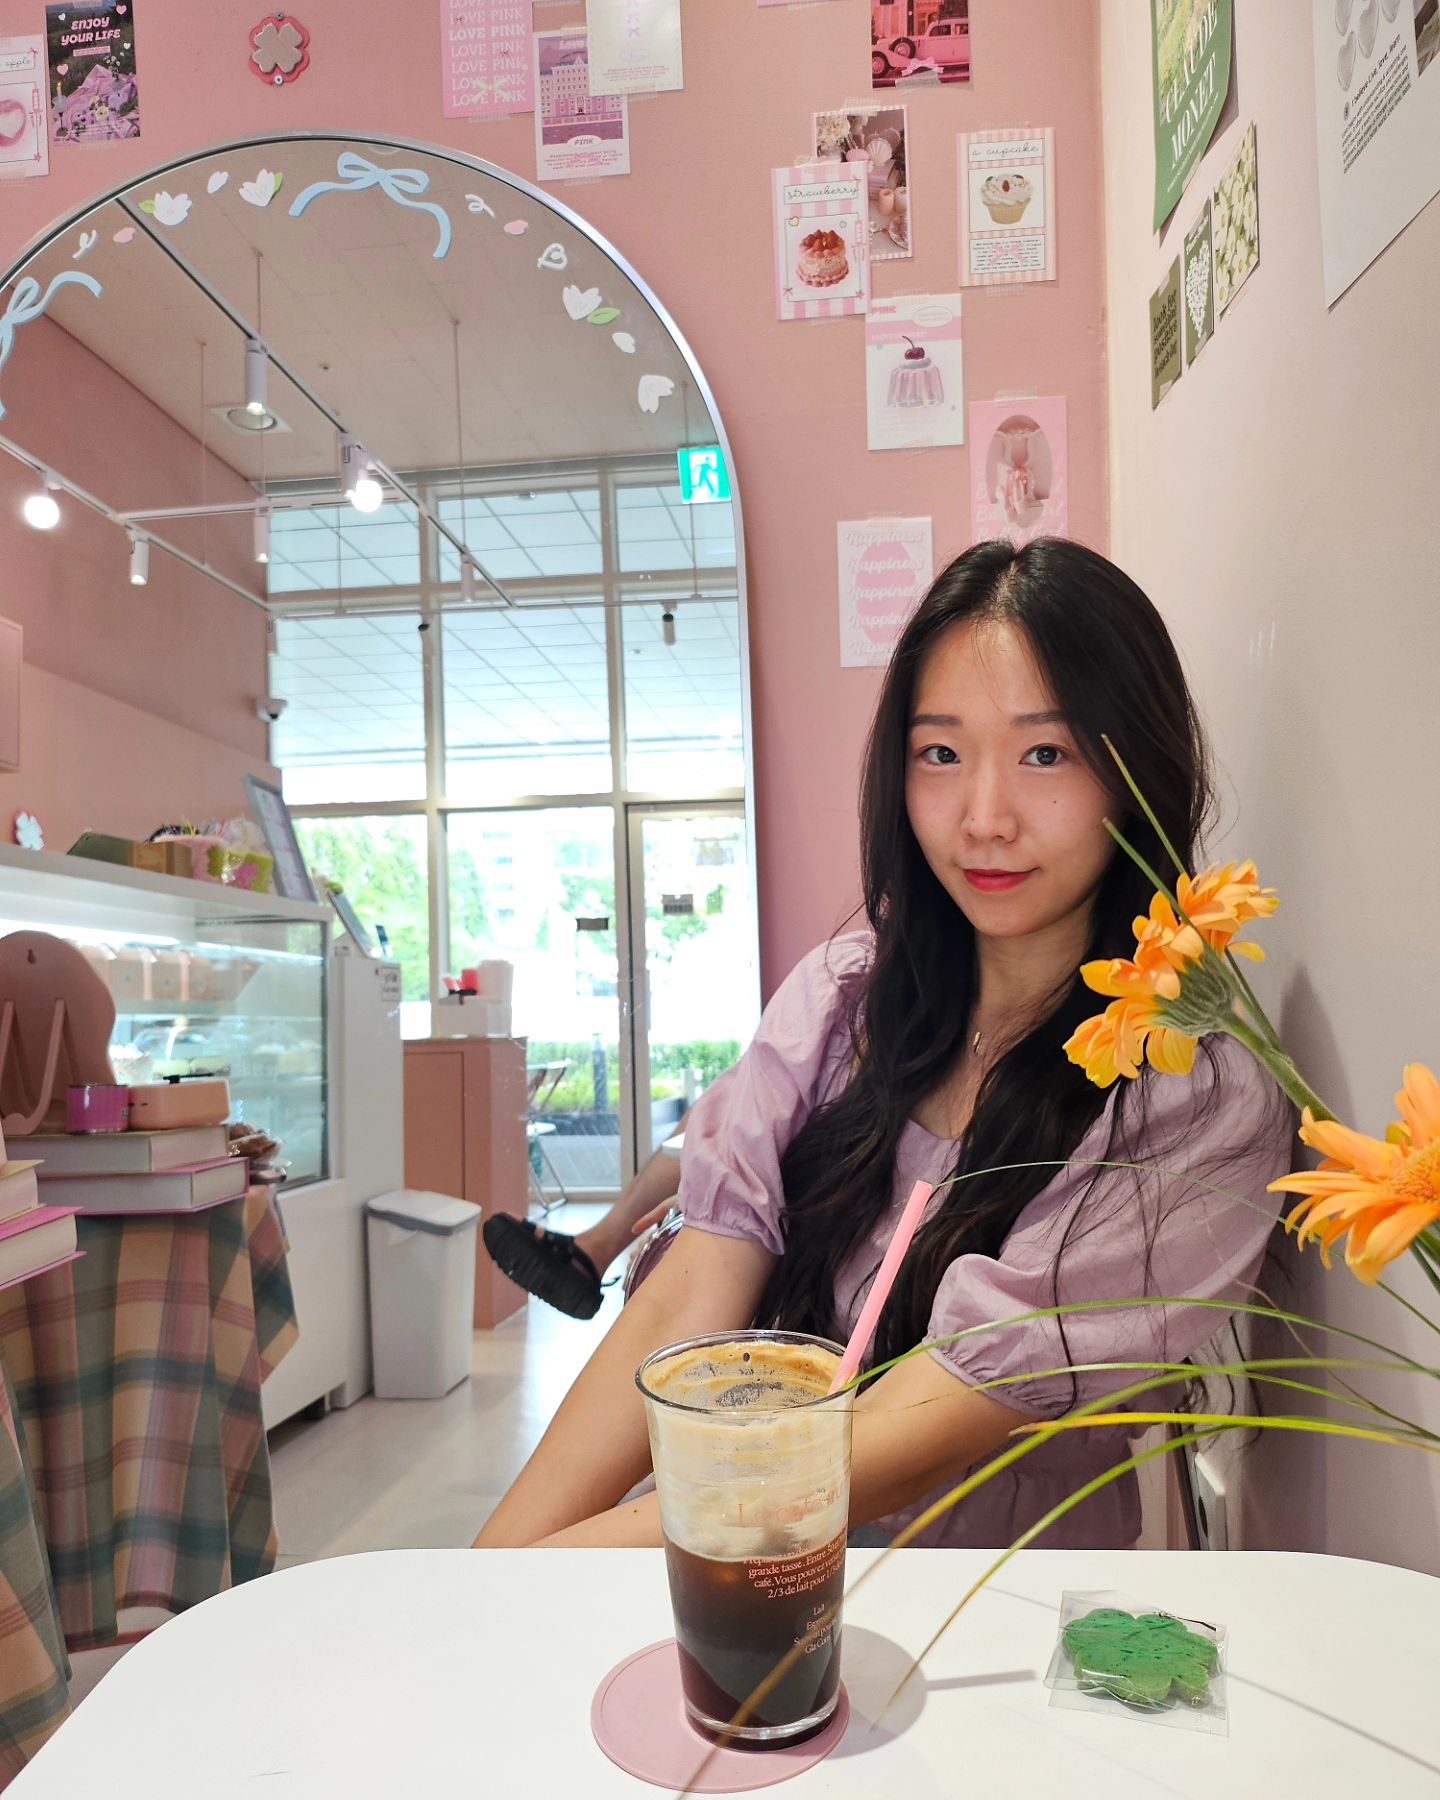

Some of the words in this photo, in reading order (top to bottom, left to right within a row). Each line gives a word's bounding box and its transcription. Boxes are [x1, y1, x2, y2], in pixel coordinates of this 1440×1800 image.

[71, 16, 110, 30] ENJOY
[449, 10, 486, 25] LOVE
[491, 7, 523, 21] PINK
[61, 32, 94, 46] YOUR
[95, 29, 121, 41] LIFE
[448, 27, 486, 41] LOVE
[490, 23, 526, 38] PINK
[451, 43, 487, 57] LOVE
[492, 40, 525, 54] PINK
[451, 59, 488, 74] LOVE
[492, 56, 526, 71] PINK
[1171, 51, 1216, 170] MONET
[748, 1564, 781, 1579] grande
[806, 1549, 827, 1566] Entre
[767, 1587, 785, 1599] 2/3
[785, 1585, 796, 1596] de
[796, 1580, 811, 1593] lait
[809, 1574, 827, 1591] pour
[774, 1573, 798, 1586] Vous
